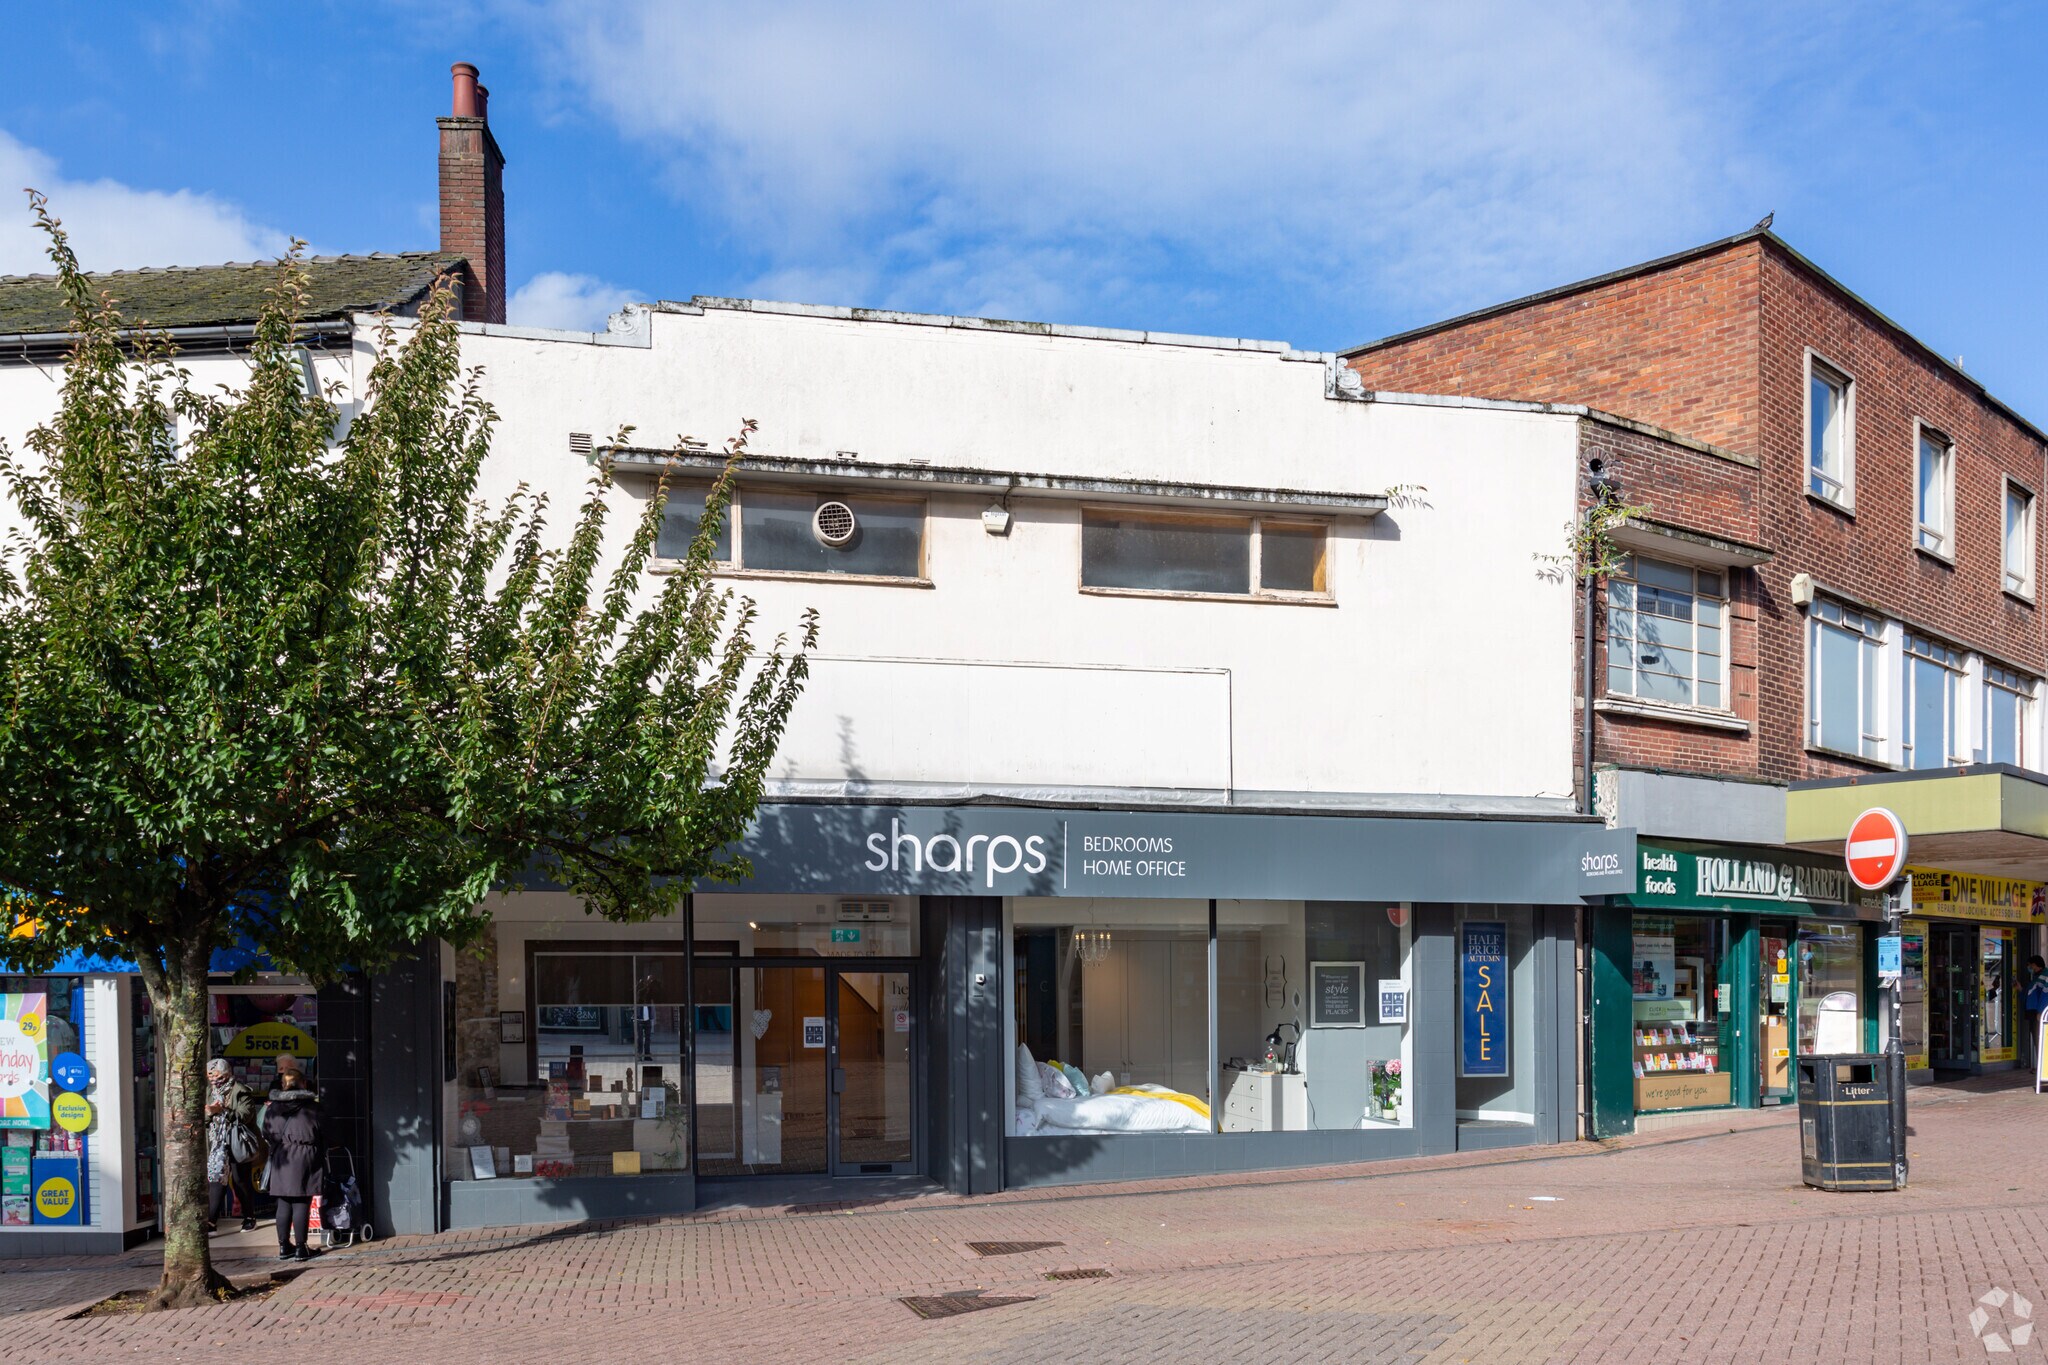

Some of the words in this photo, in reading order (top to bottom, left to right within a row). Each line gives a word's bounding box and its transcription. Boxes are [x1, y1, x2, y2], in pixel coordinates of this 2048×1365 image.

[865, 818, 1047, 888] sharps
[1083, 837, 1173, 853] BEDROOMS
[1083, 859, 1132, 876] HOME
[1135, 860, 1186, 877] OFFICE
[1582, 851, 1618, 875] sharps
[1643, 852, 1678, 872] health
[1645, 875, 1677, 894] foods
[1696, 856, 1777, 896] HOLLAND
[1777, 863, 1793, 901] &
[1794, 865, 1851, 906] BARRETT
[1952, 875, 1977, 904] ONE
[1980, 879, 2027, 908] VILLAGE
[1937, 903, 1956, 913] REPAIR
[1959, 905, 1987, 916] UNLOCKING
[1990, 907, 2022, 918] ACCESSORIES
[1468, 934, 1500, 945] HALF
[1468, 945, 1500, 955] PRICE
[1325, 983, 1349, 996] style
[1476, 965, 1493, 1061] SALE
[22, 1021, 37, 1031] 29p
[0, 1037, 14, 1046] EW
[0, 1050, 33, 1073] hday
[1645, 1088, 1663, 1099] we're
[1664, 1085, 1681, 1100] good
[1682, 1084, 1692, 1098] for
[1693, 1086, 1708, 1100] you
[1845, 1086, 1870, 1098] Litter
[41, 1190, 69, 1198] GREAT
[42, 1198, 69, 1206] VALUE
